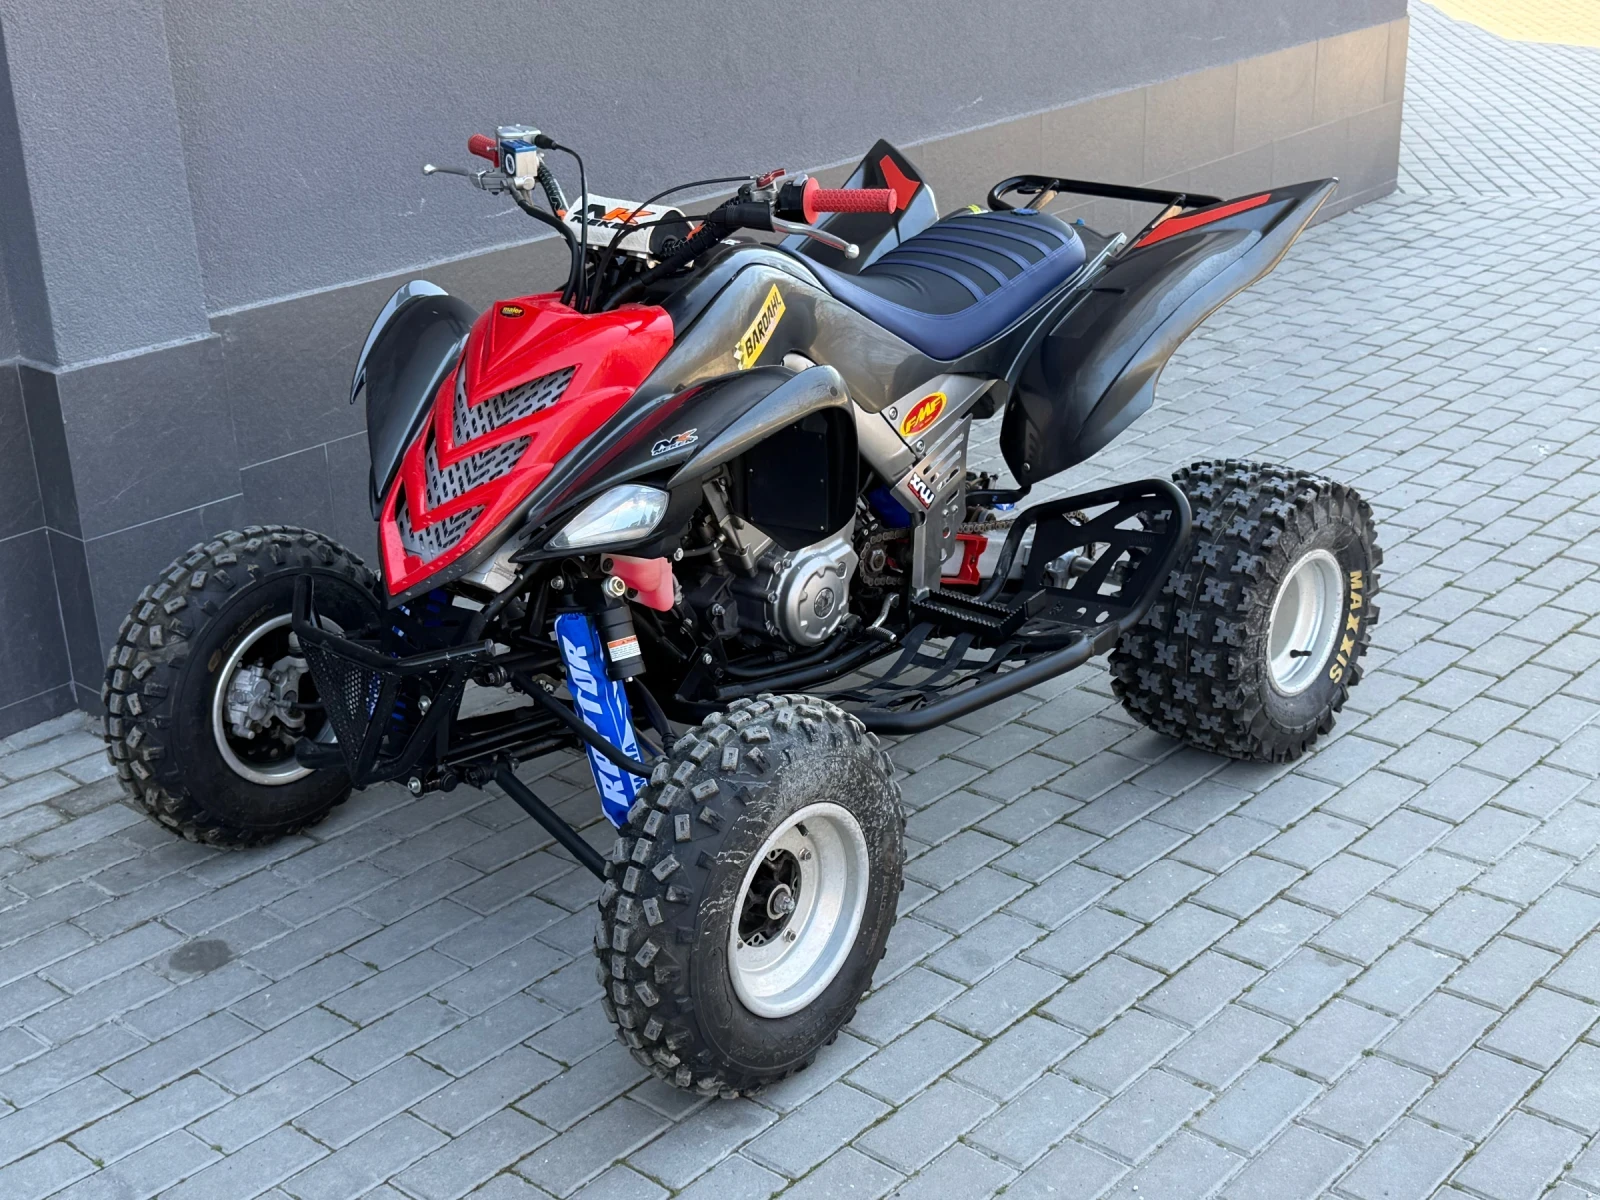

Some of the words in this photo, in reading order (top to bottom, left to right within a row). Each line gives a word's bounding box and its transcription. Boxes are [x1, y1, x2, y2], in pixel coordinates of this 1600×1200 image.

[570, 216, 646, 231] NEKE
[745, 292, 781, 358] BARDAHL
[905, 395, 941, 433] FMF
[1330, 570, 1363, 683] MAXXIS
